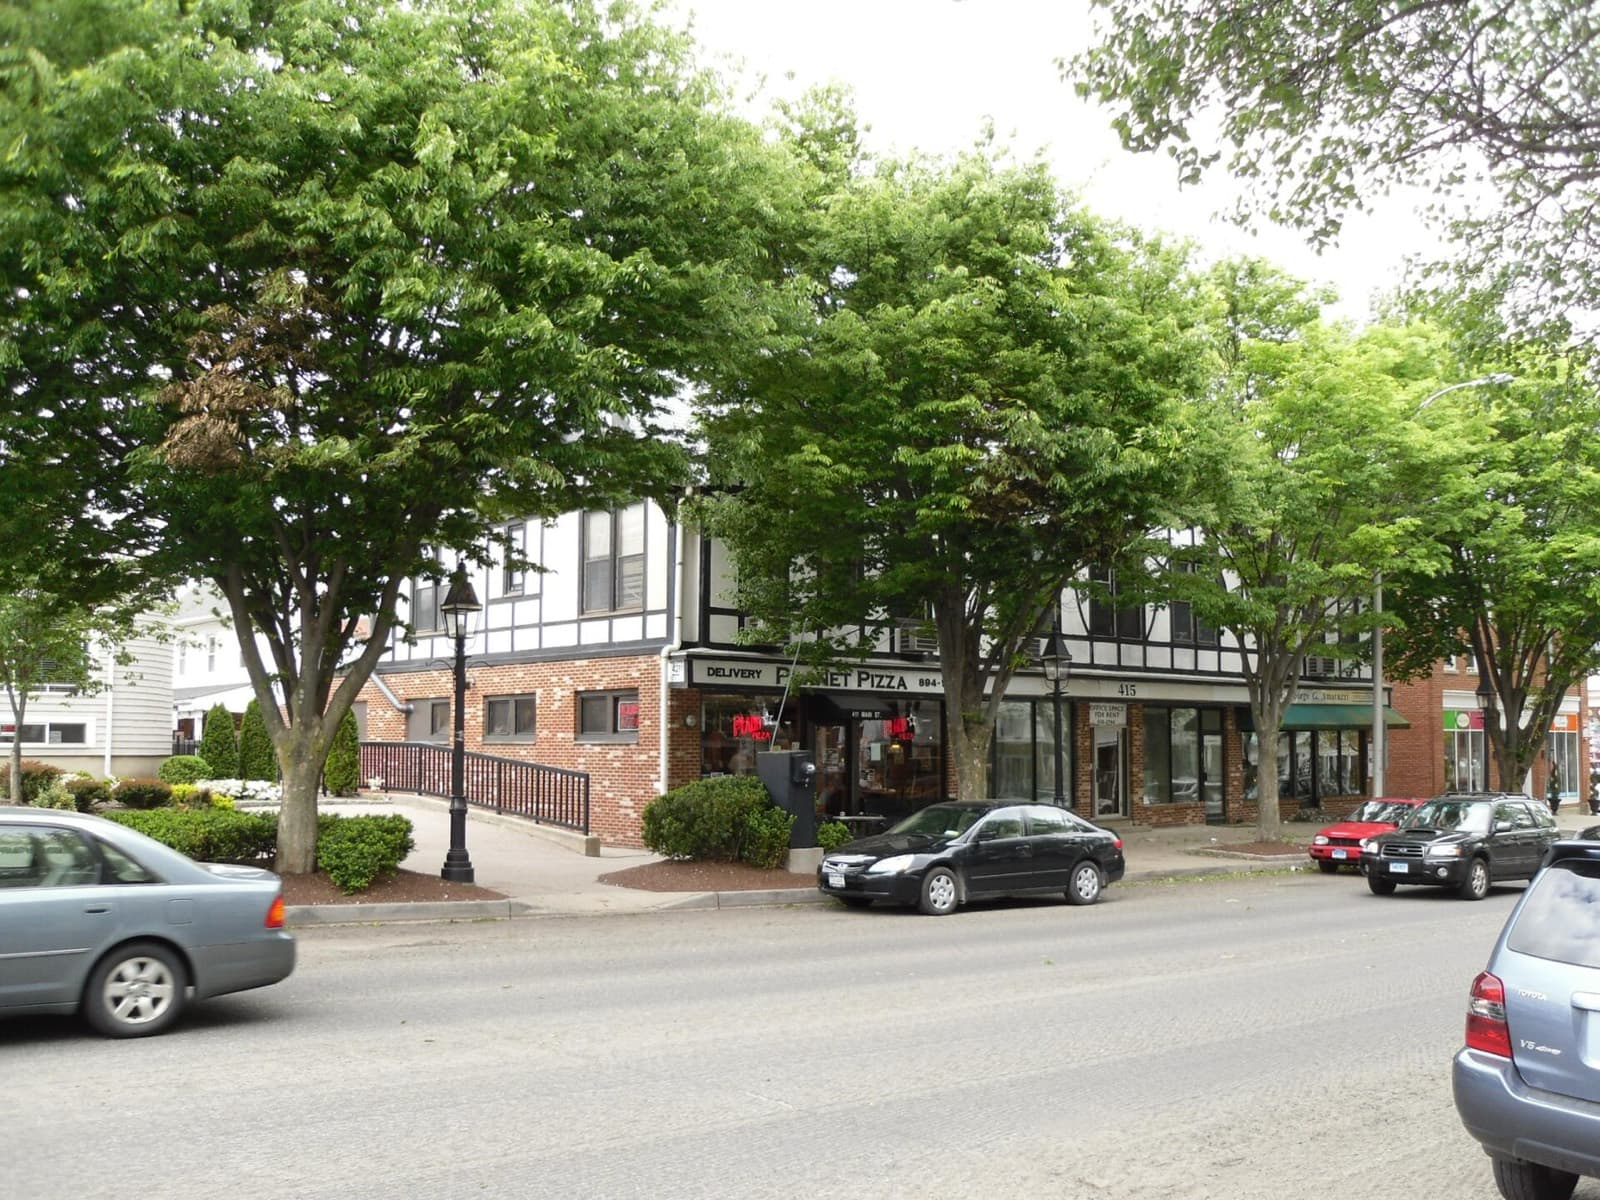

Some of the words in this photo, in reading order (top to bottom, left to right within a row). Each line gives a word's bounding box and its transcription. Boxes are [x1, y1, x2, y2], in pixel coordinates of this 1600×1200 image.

[707, 666, 763, 679] DELIVERY
[857, 670, 908, 690] PIZZA
[1118, 682, 1137, 697] 415
[1518, 988, 1548, 1001] TOYOTA
